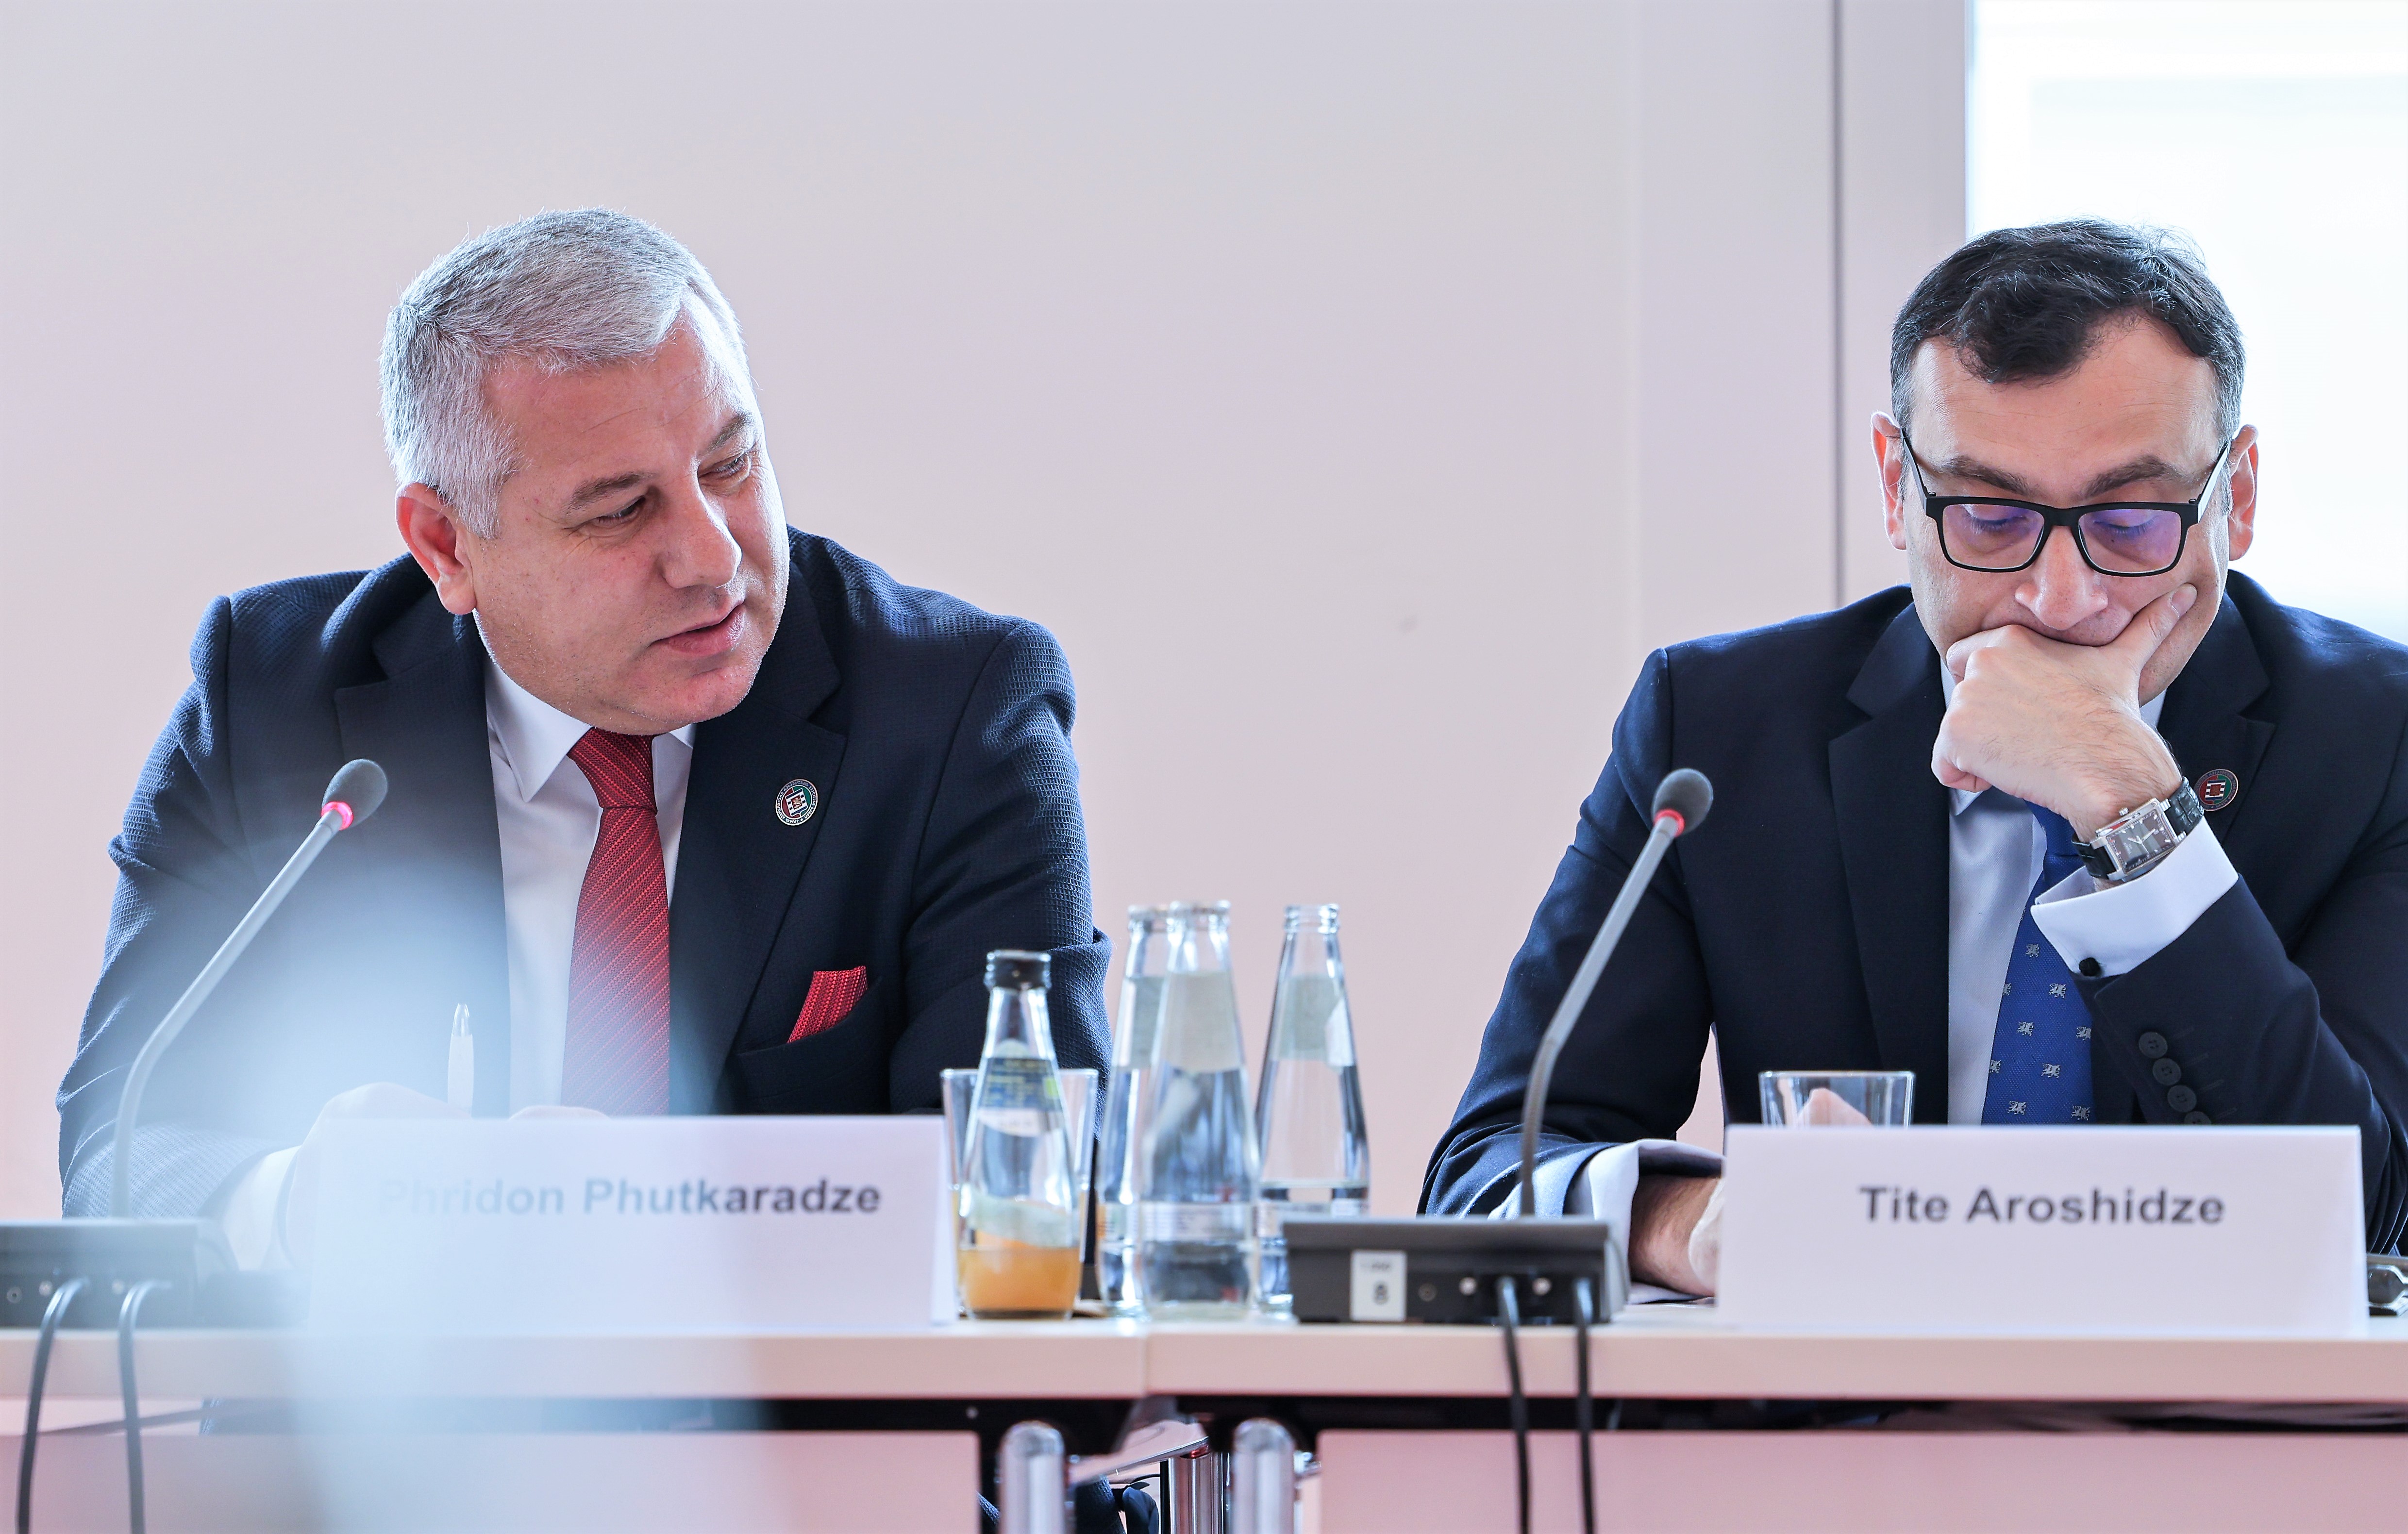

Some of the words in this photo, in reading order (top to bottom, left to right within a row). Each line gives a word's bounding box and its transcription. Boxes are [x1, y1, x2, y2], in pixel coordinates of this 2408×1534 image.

[380, 1177, 566, 1215] Phridon
[583, 1176, 884, 1215] Phutkaradze
[1859, 1186, 1950, 1222] Tite
[1965, 1187, 2225, 1224] Aroshidze
